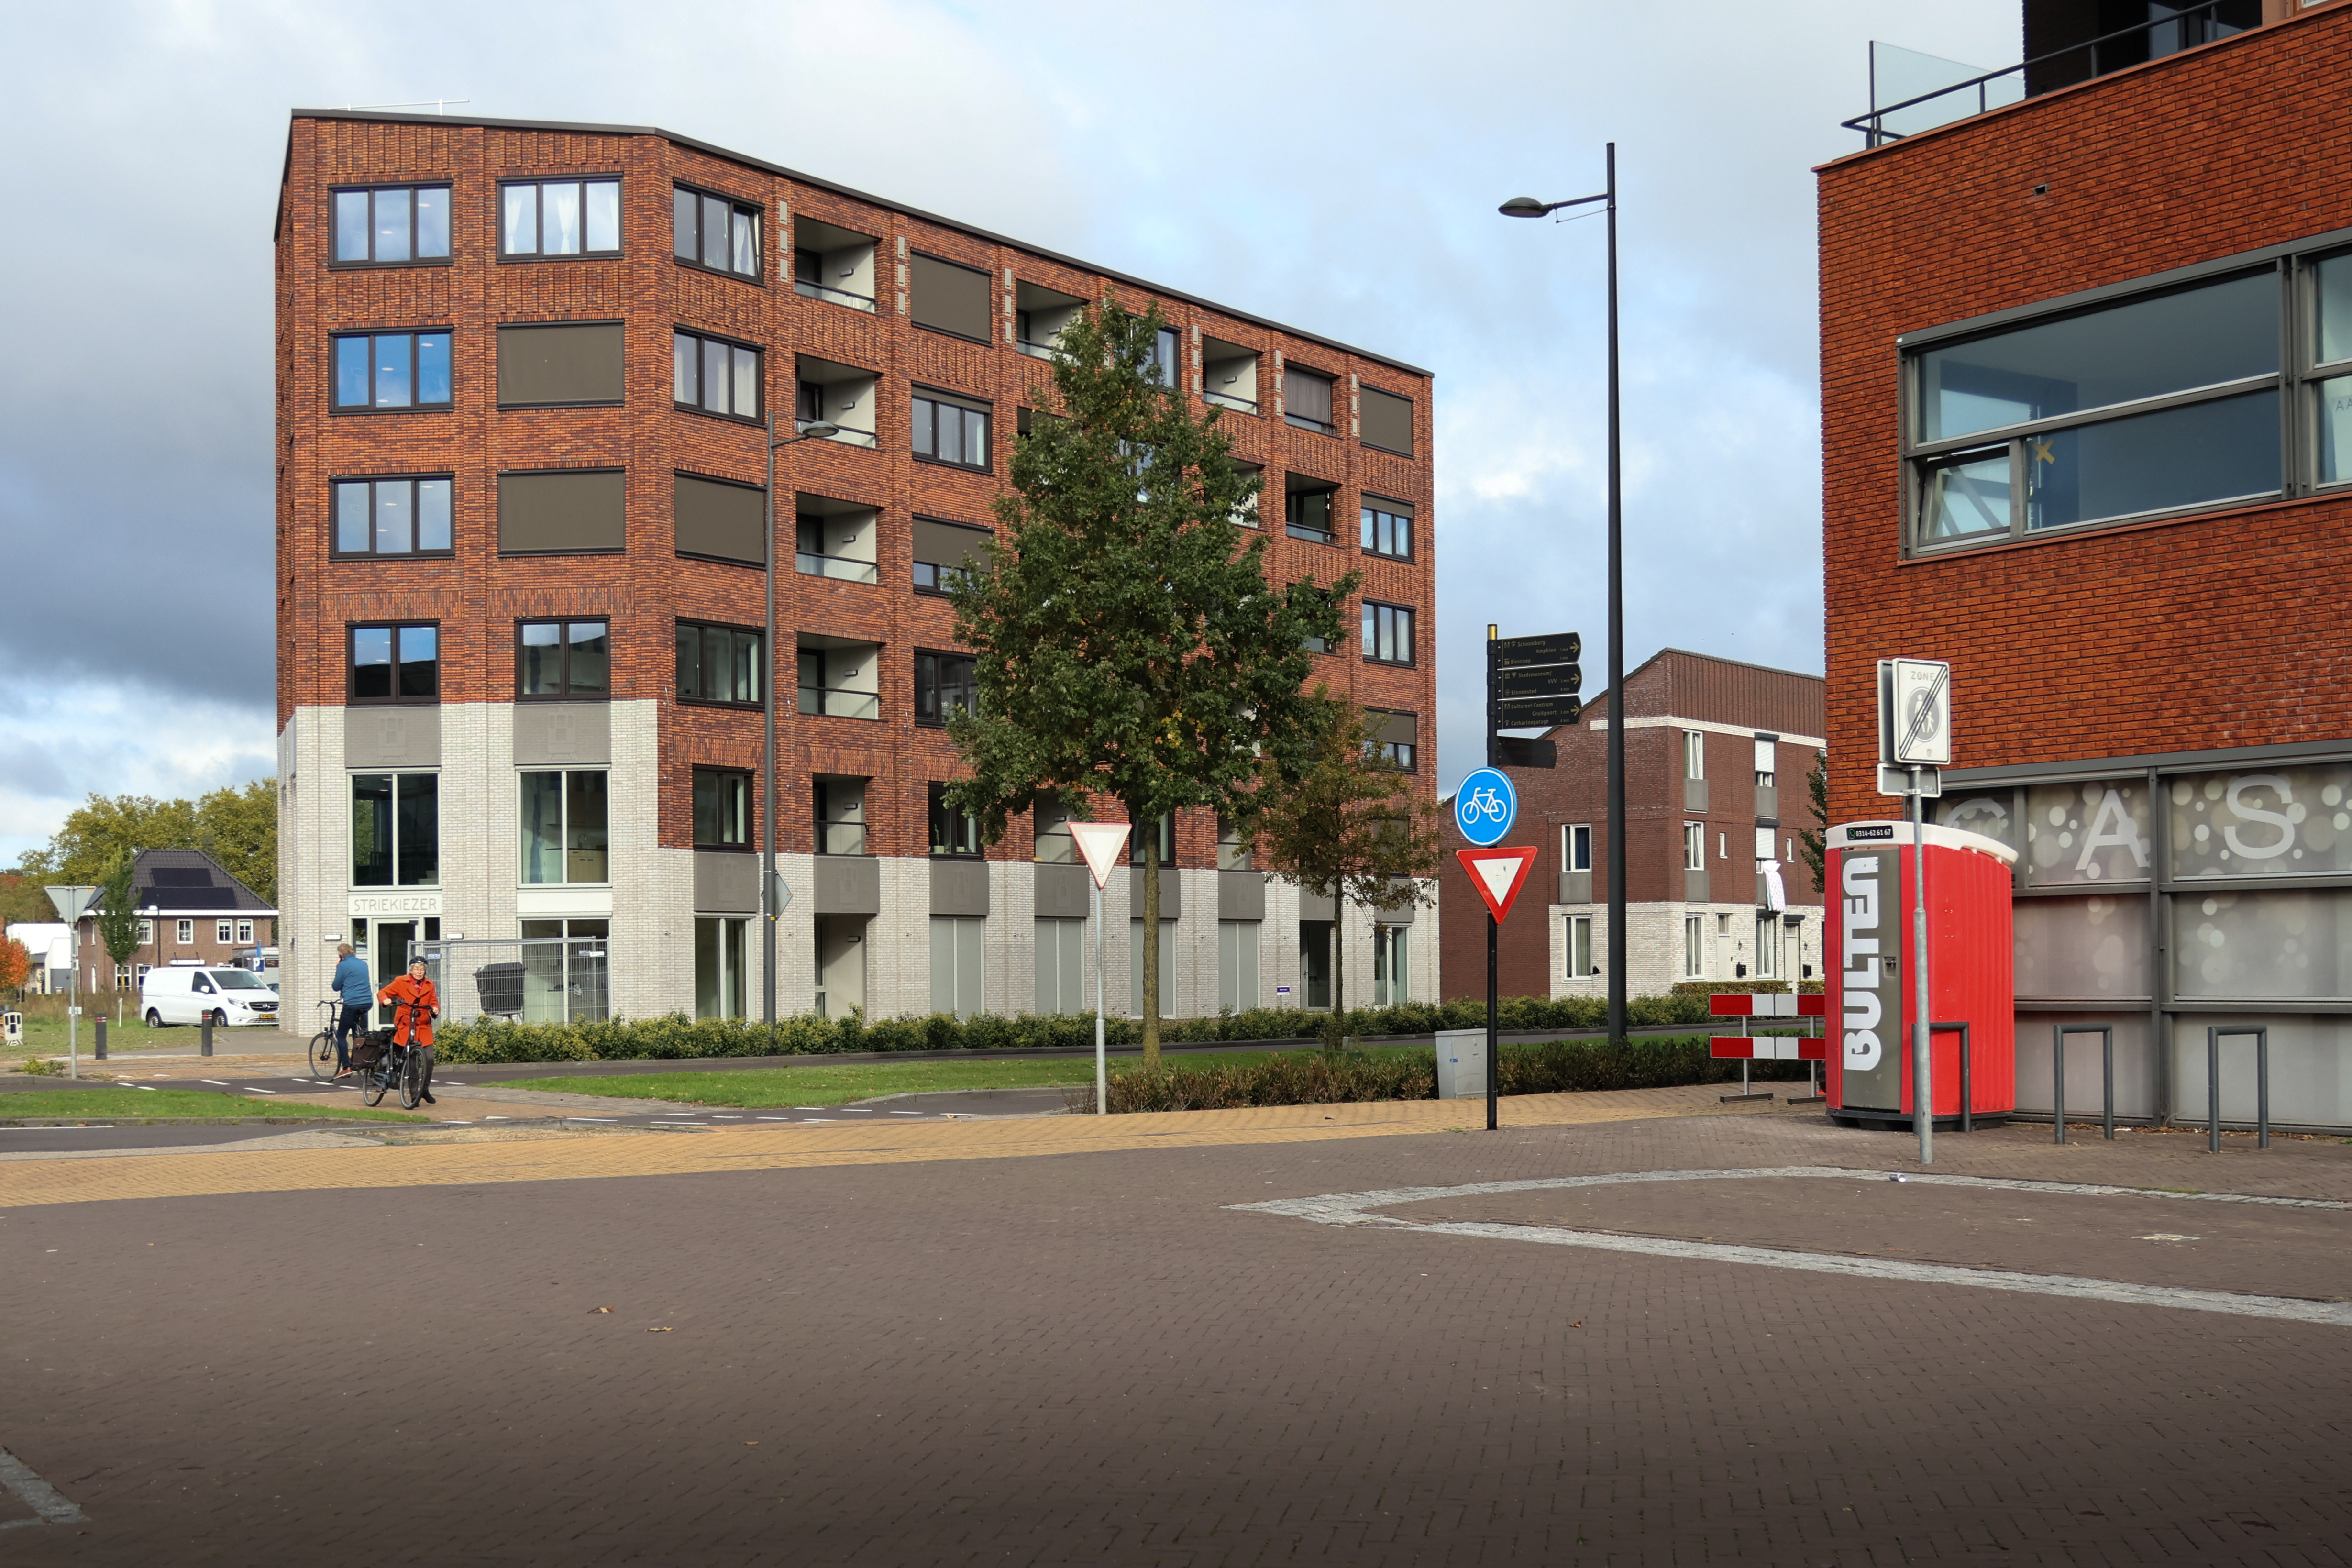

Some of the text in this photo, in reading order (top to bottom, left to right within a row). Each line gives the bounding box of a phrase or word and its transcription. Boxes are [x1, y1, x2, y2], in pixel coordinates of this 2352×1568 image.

[1911, 671, 1935, 681] ZONE
[354, 898, 437, 911] STRIEKIEZER
[253, 958, 261, 971] P
[1843, 856, 1881, 1071] BULTEN
